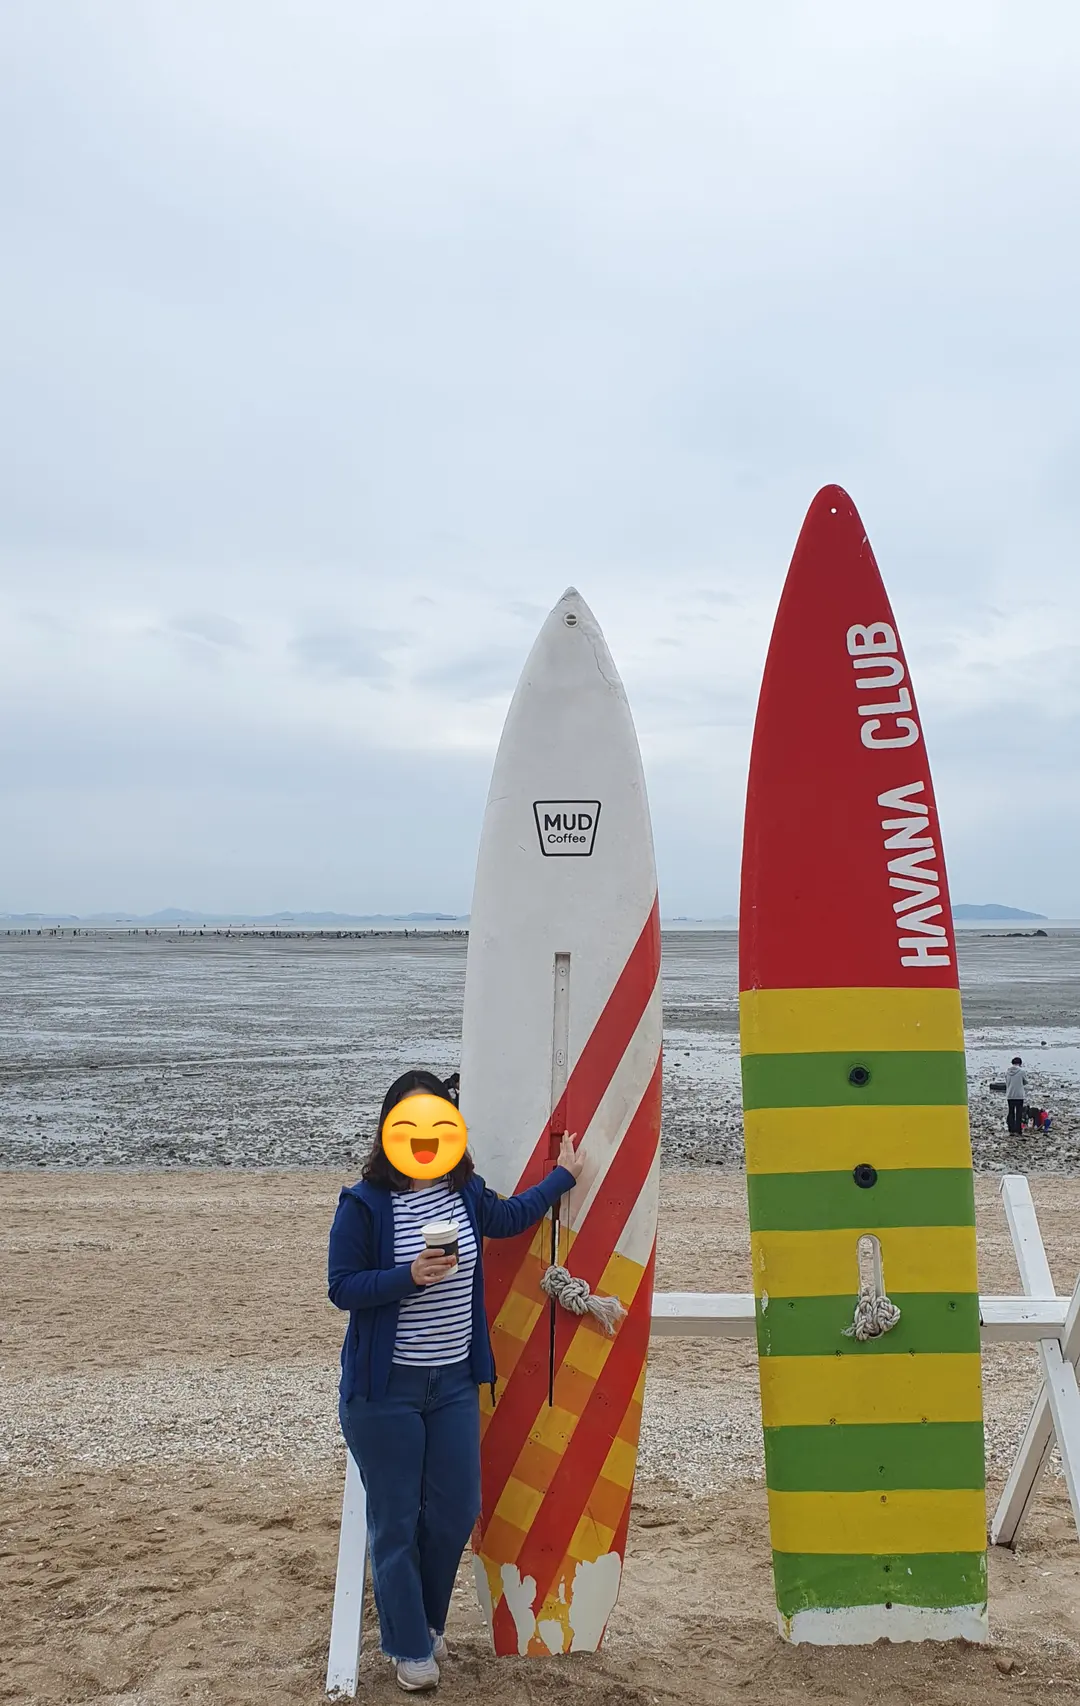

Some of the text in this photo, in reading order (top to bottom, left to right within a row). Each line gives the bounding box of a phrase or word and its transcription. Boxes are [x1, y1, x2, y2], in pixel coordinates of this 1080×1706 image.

[846, 621, 951, 968] HAVANA CLUB
[544, 813, 593, 831] MUD
[547, 833, 587, 844] Coffee
